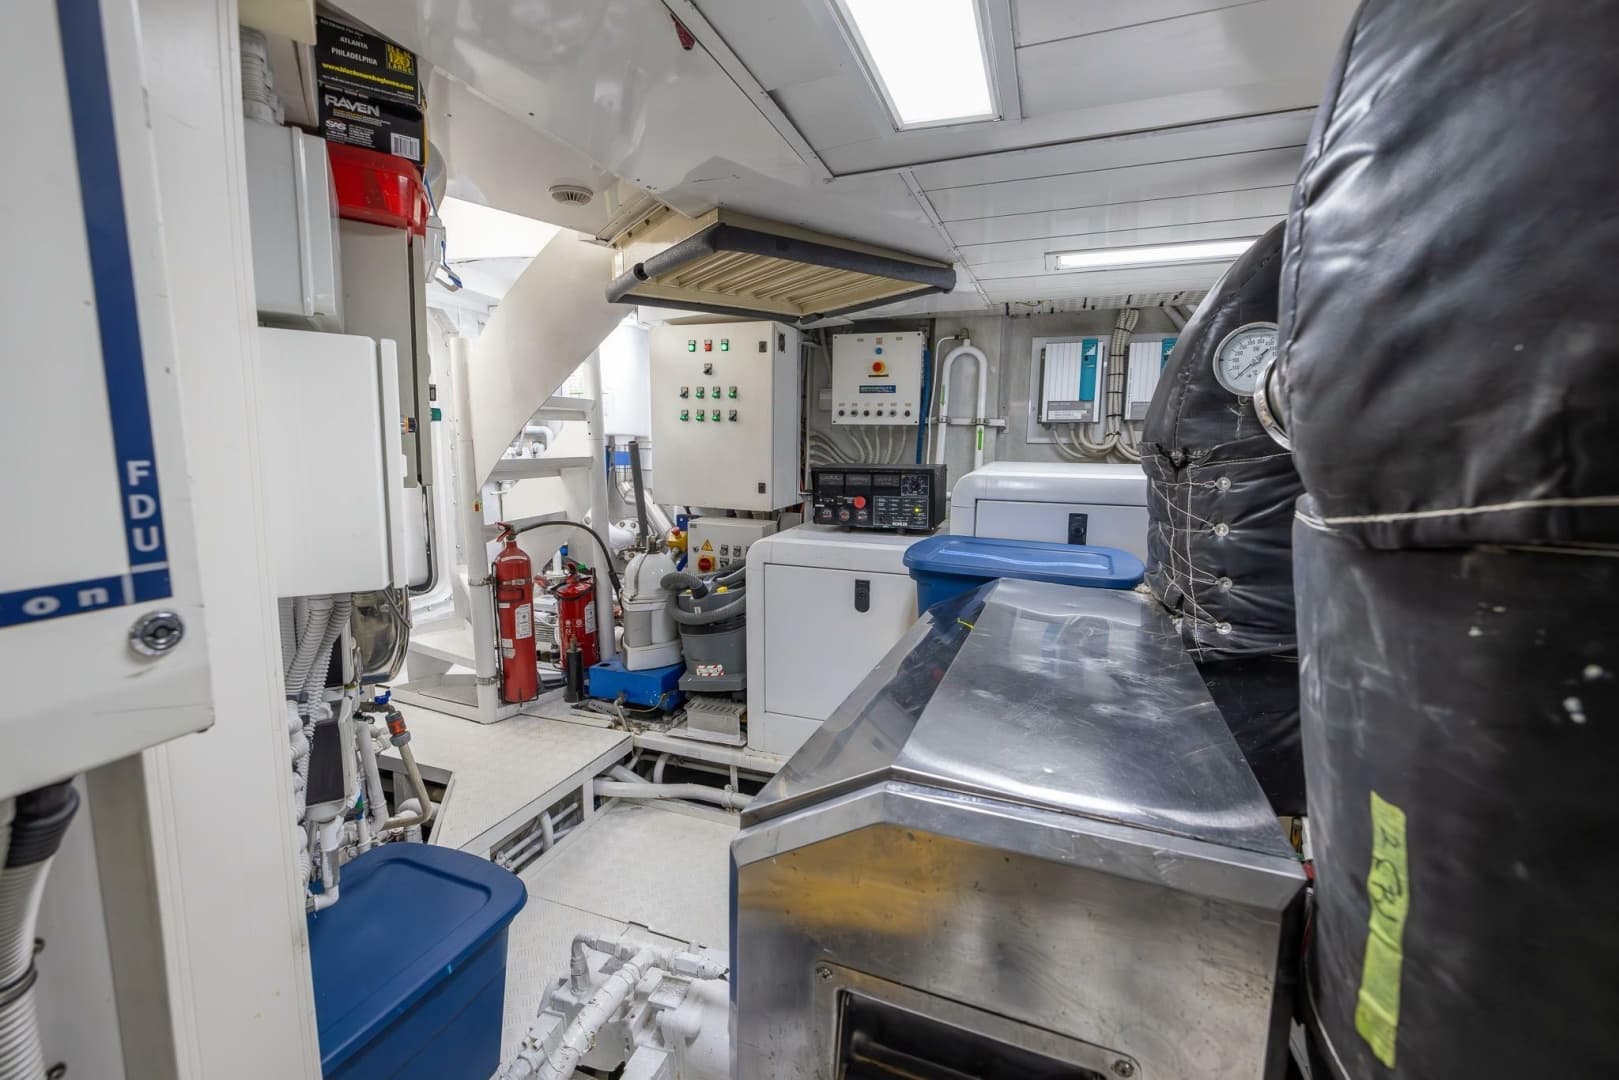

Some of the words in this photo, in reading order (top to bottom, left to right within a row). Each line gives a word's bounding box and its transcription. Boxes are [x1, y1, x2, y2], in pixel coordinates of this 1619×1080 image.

[340, 36, 368, 49] ATLANTA
[331, 47, 378, 66] PHILADELPHIA
[325, 94, 380, 117] RAVEN
[126, 460, 160, 552] FDU
